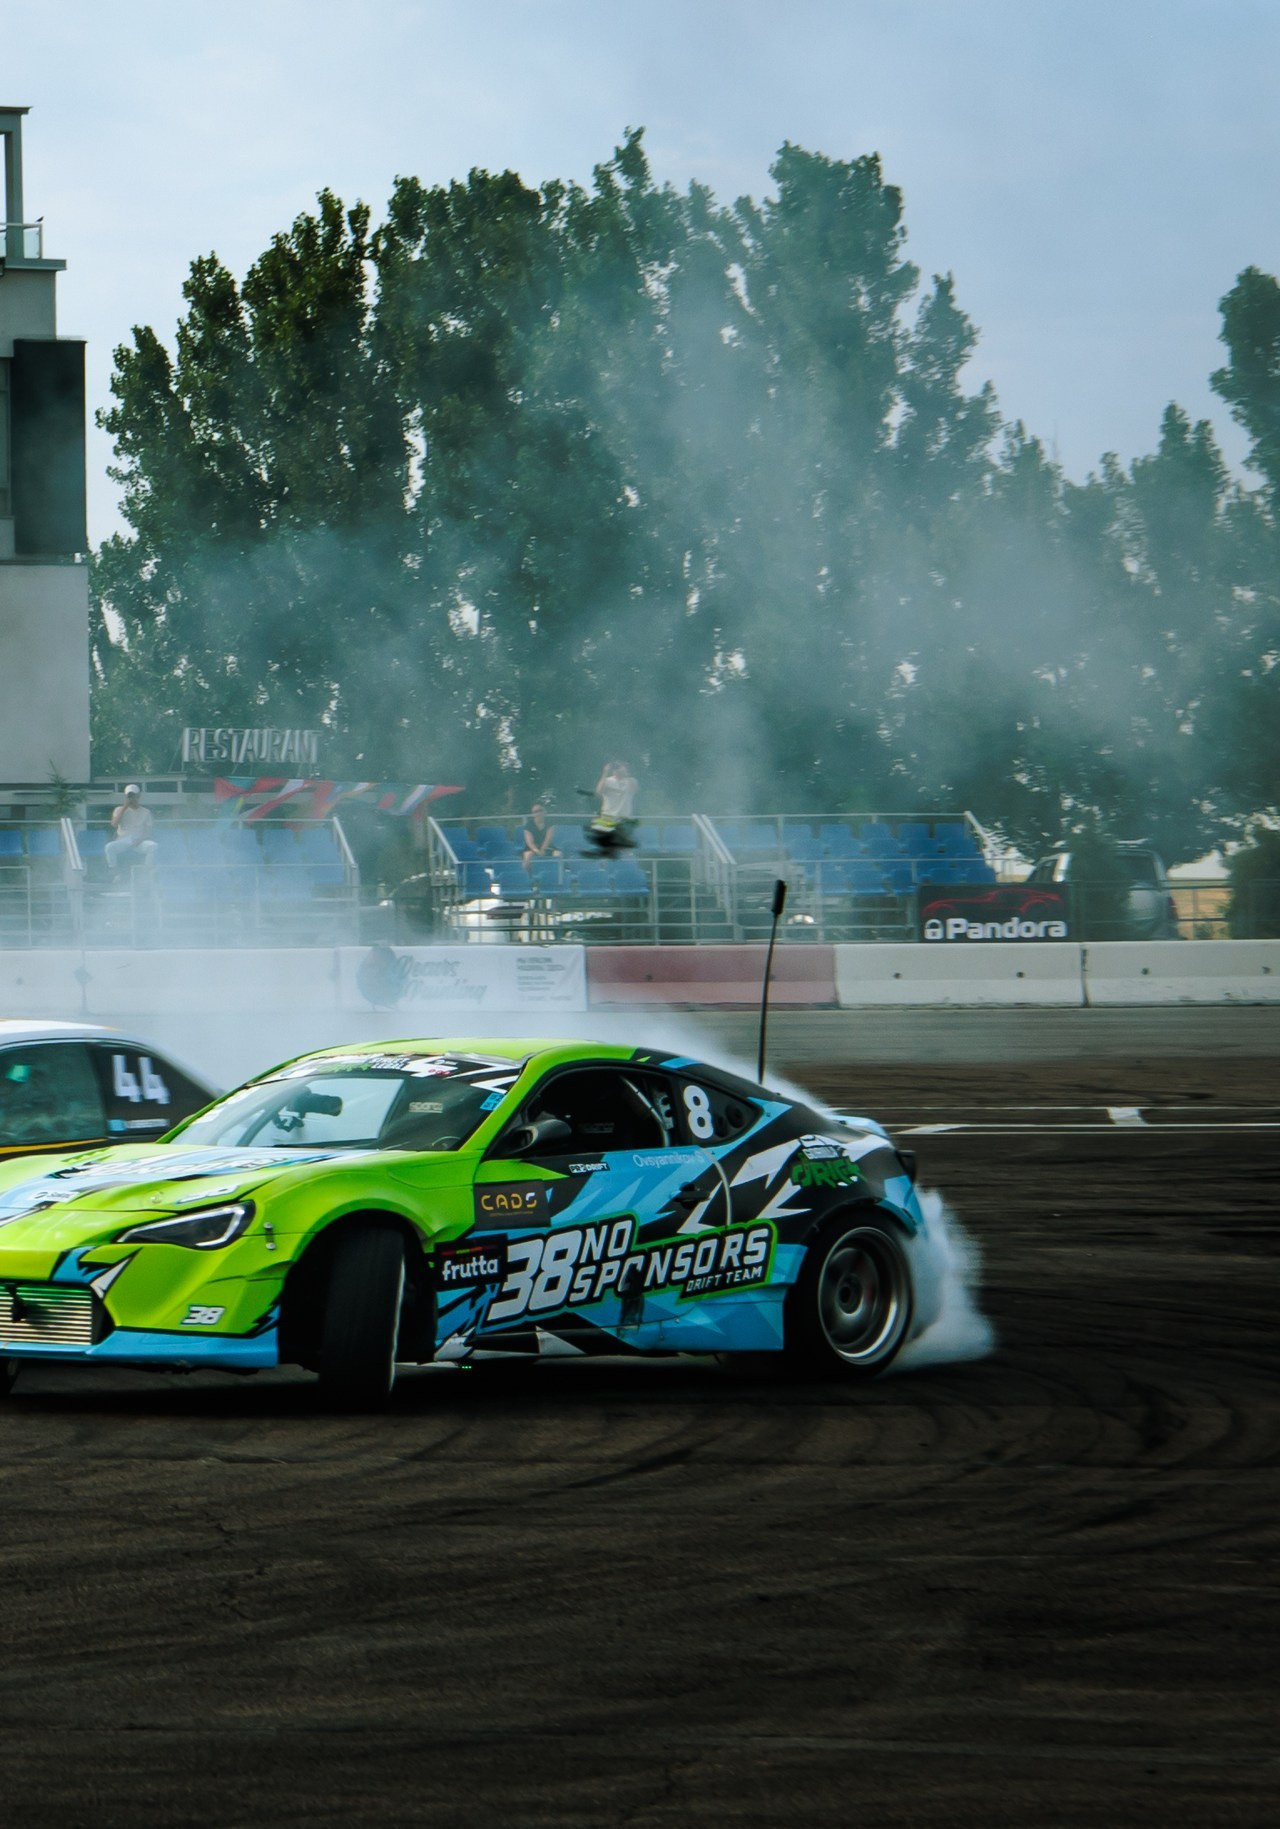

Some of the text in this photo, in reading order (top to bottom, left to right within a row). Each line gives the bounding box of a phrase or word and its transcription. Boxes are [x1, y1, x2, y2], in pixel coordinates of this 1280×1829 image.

[182, 728, 320, 763] RESTAURANT
[946, 917, 1067, 940] Pandora
[112, 1055, 170, 1105] 44
[682, 1084, 713, 1139] 8
[481, 1192, 538, 1211] CADS
[580, 1220, 633, 1265] NO
[442, 1255, 499, 1282] frutta
[487, 1230, 583, 1321] 38
[569, 1229, 769, 1302] SPONSORS
[685, 1267, 764, 1293] DRIFT TEAM
[181, 1306, 226, 1324] 38
